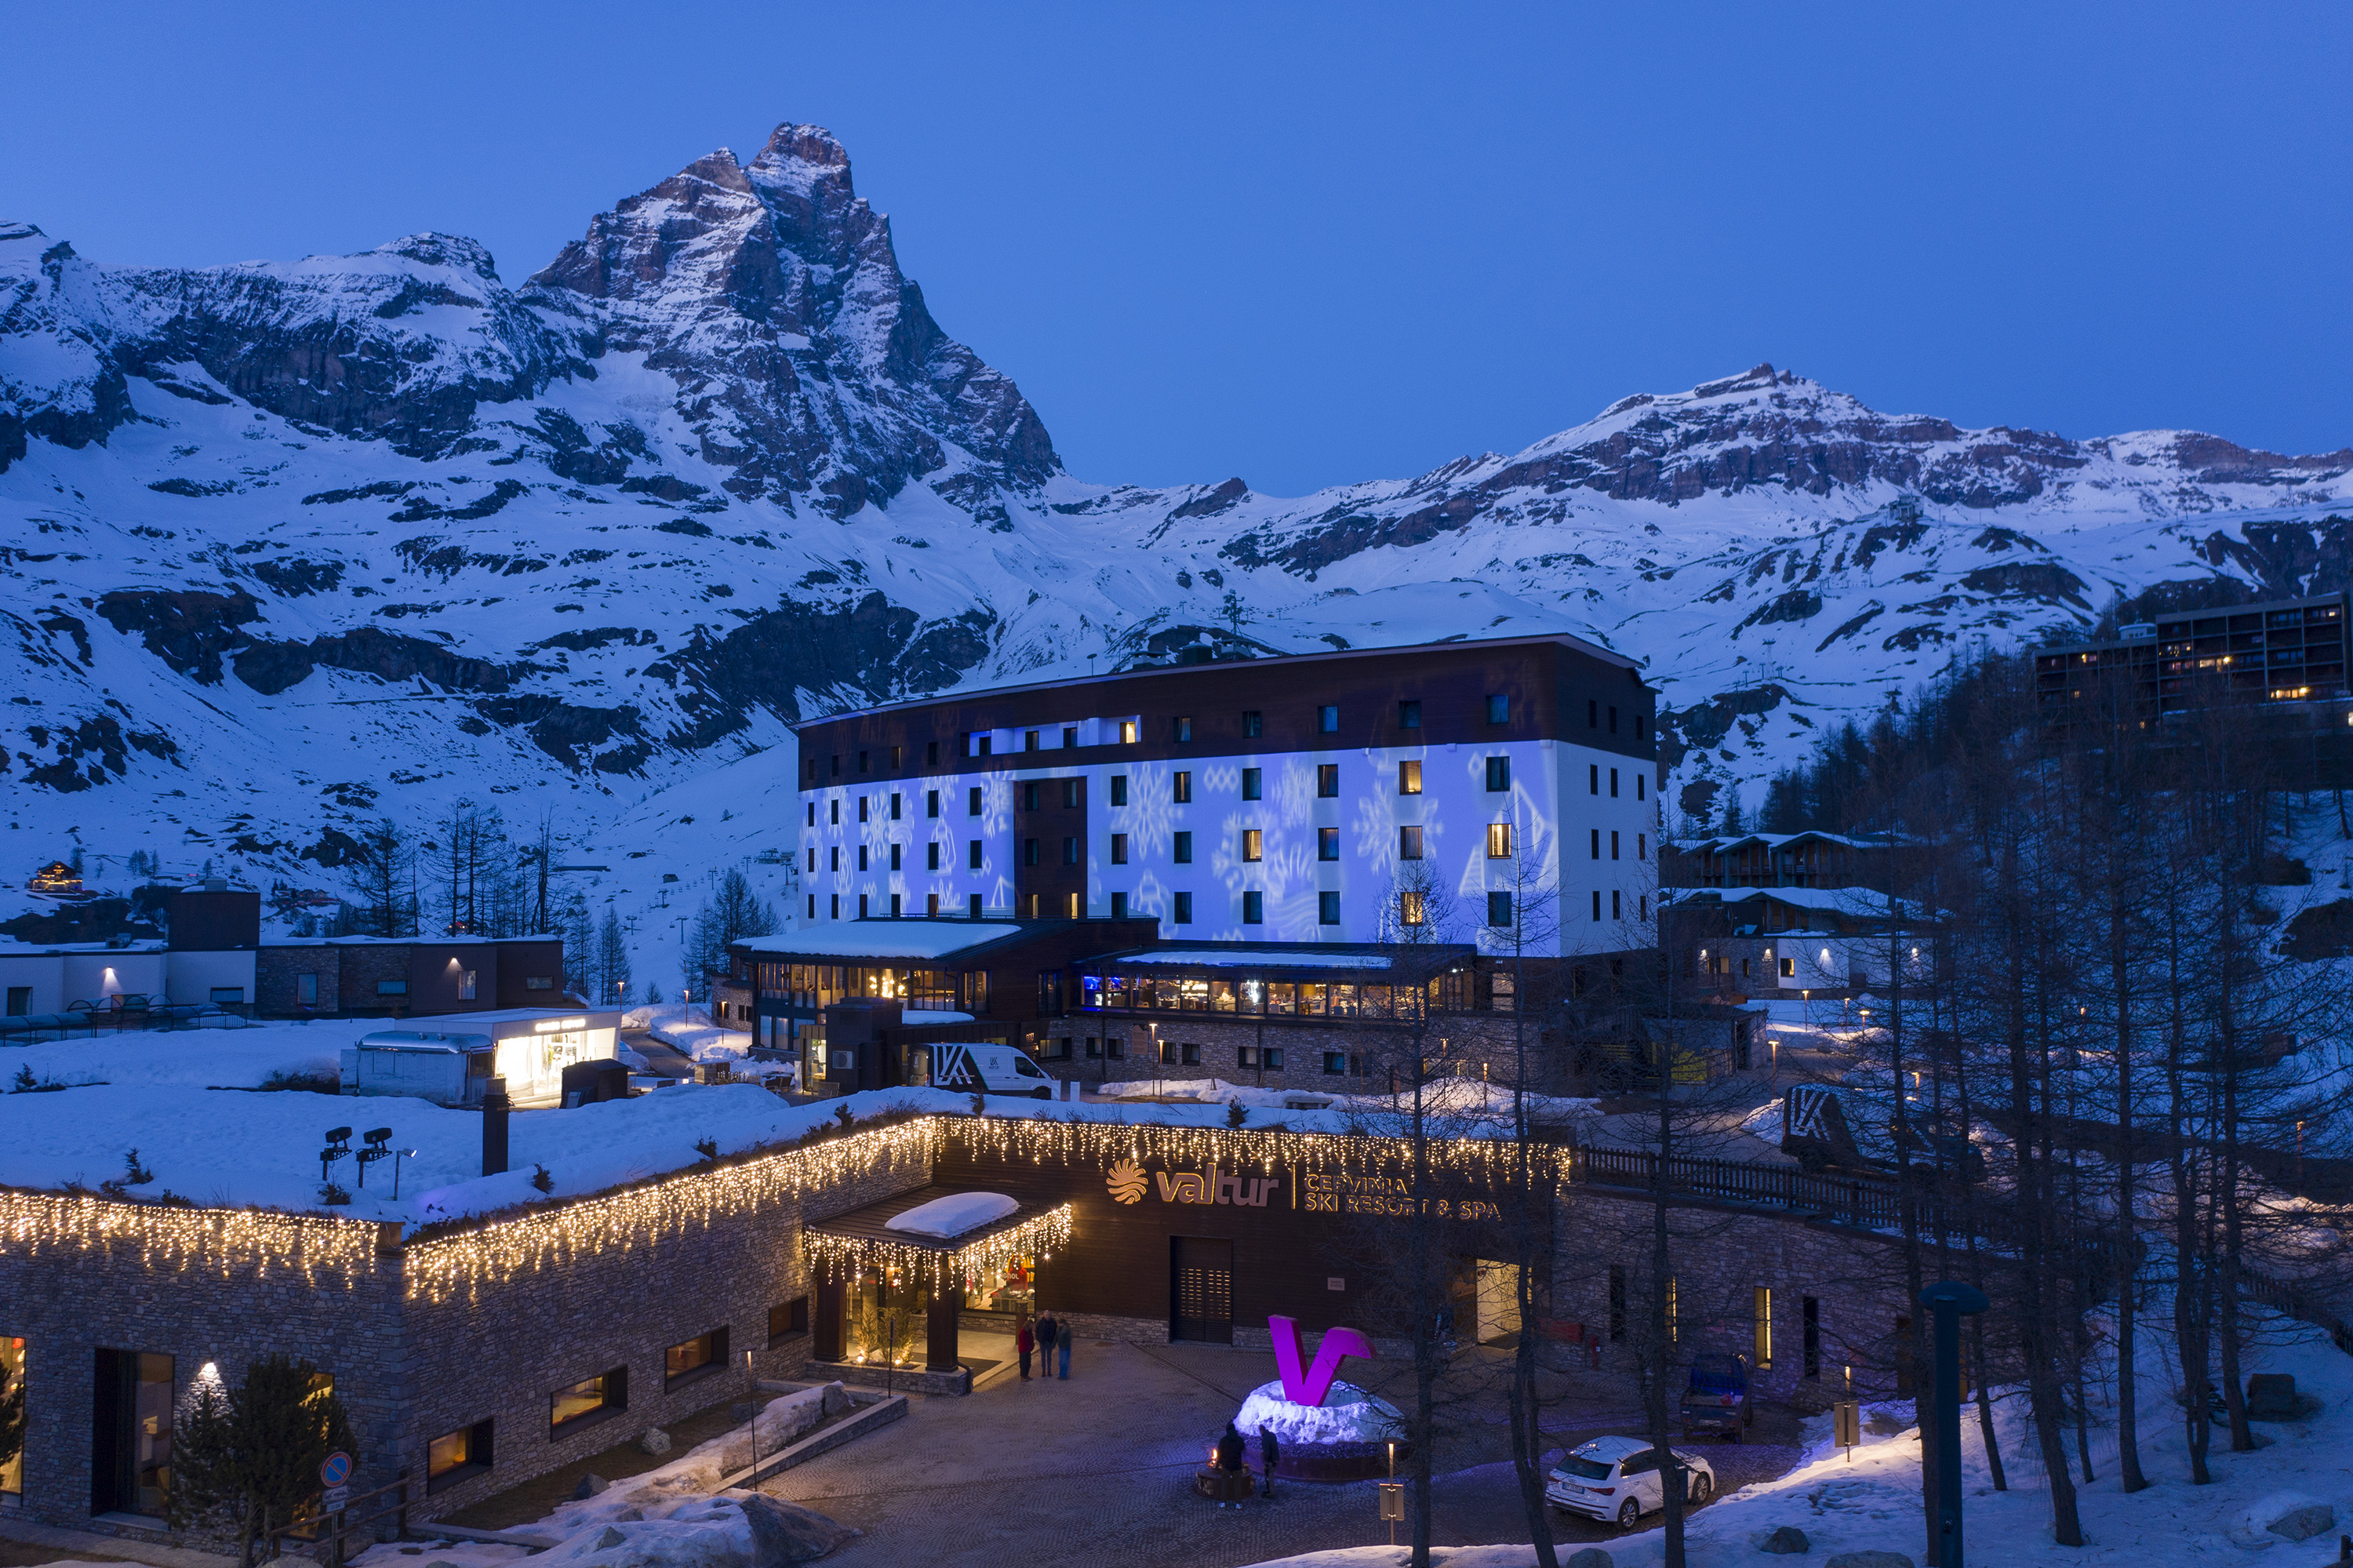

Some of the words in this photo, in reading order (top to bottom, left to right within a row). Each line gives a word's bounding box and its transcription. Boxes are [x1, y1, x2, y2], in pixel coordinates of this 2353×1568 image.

[1156, 1162, 1279, 1207] valtur
[1303, 1173, 1408, 1195] CERVINIA
[1303, 1192, 1338, 1212] SKI
[1435, 1199, 1452, 1218] &
[1458, 1201, 1502, 1221] SPA
